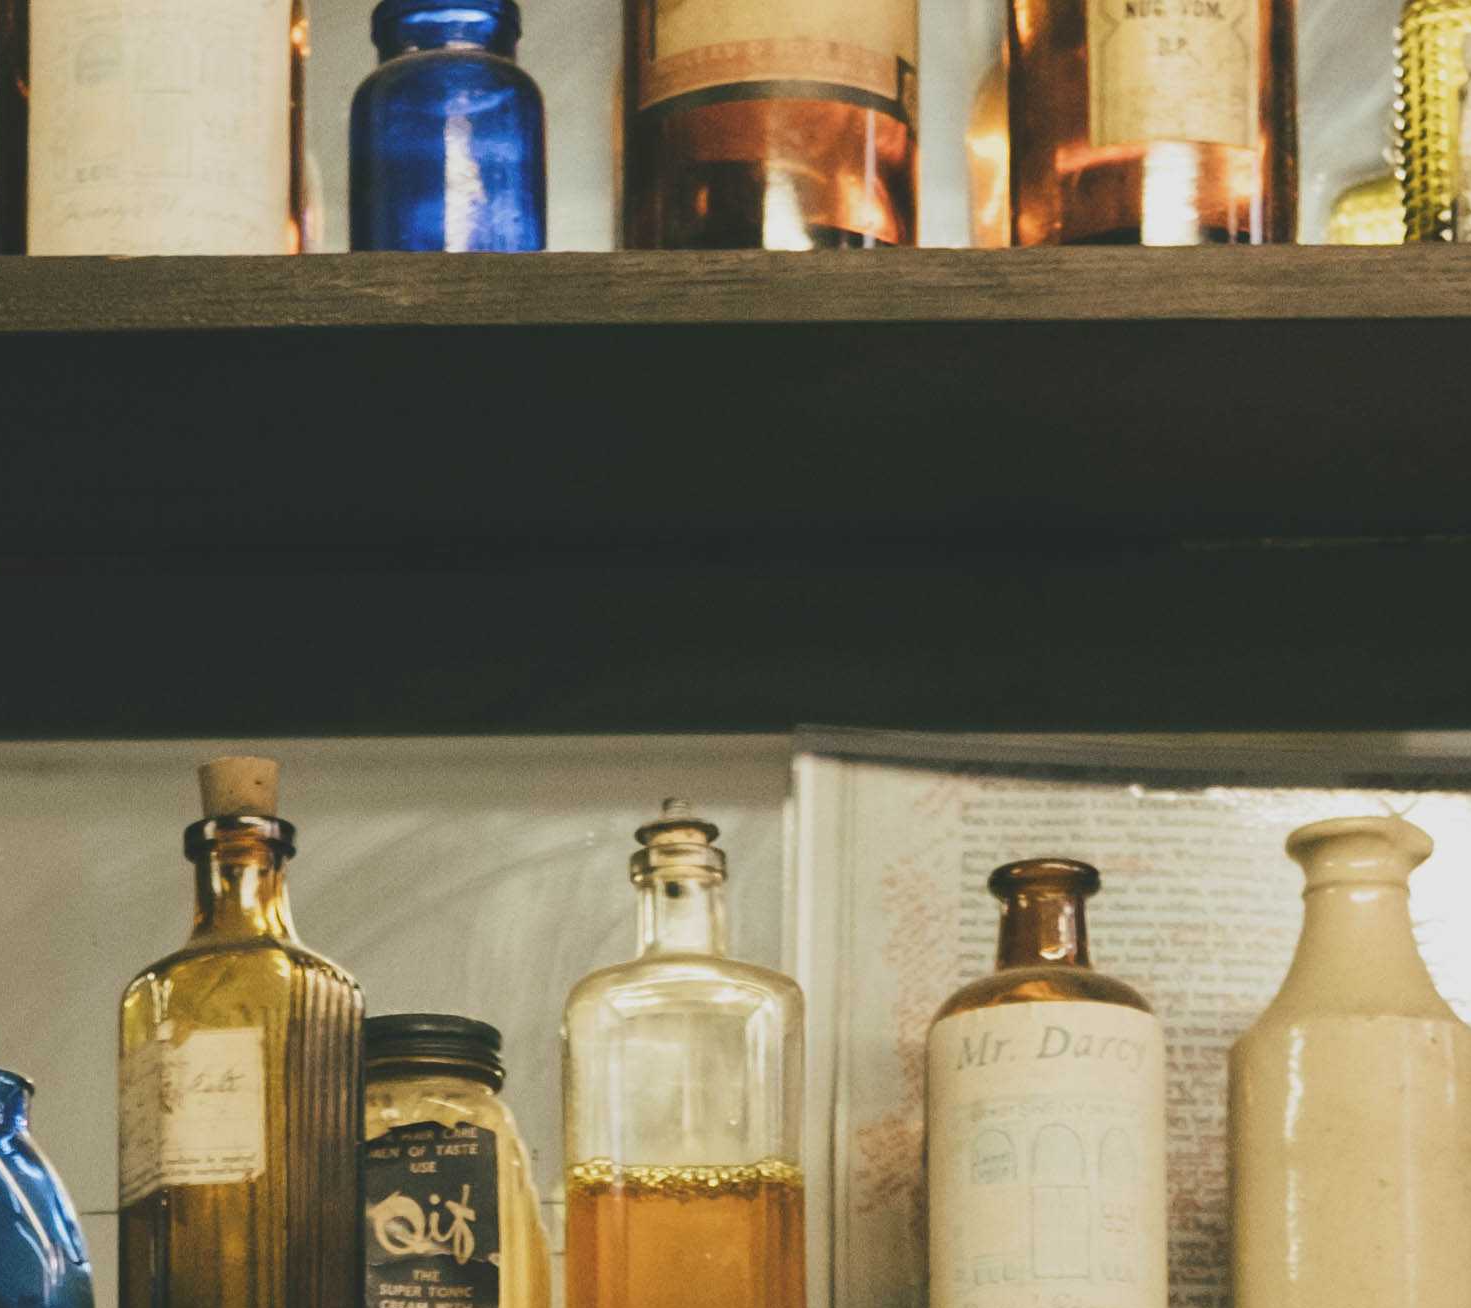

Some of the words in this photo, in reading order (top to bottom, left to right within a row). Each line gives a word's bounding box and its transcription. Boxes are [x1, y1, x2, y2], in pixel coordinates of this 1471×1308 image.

[956, 1031, 1015, 1072] Mr.
[1037, 1025, 1147, 1074] Darcy
[407, 1145, 427, 1158] OF
[435, 1143, 479, 1156] TASTE
[408, 1161, 438, 1174] USE
[412, 1268, 441, 1282] THE
[378, 1283, 423, 1298] SUPER
